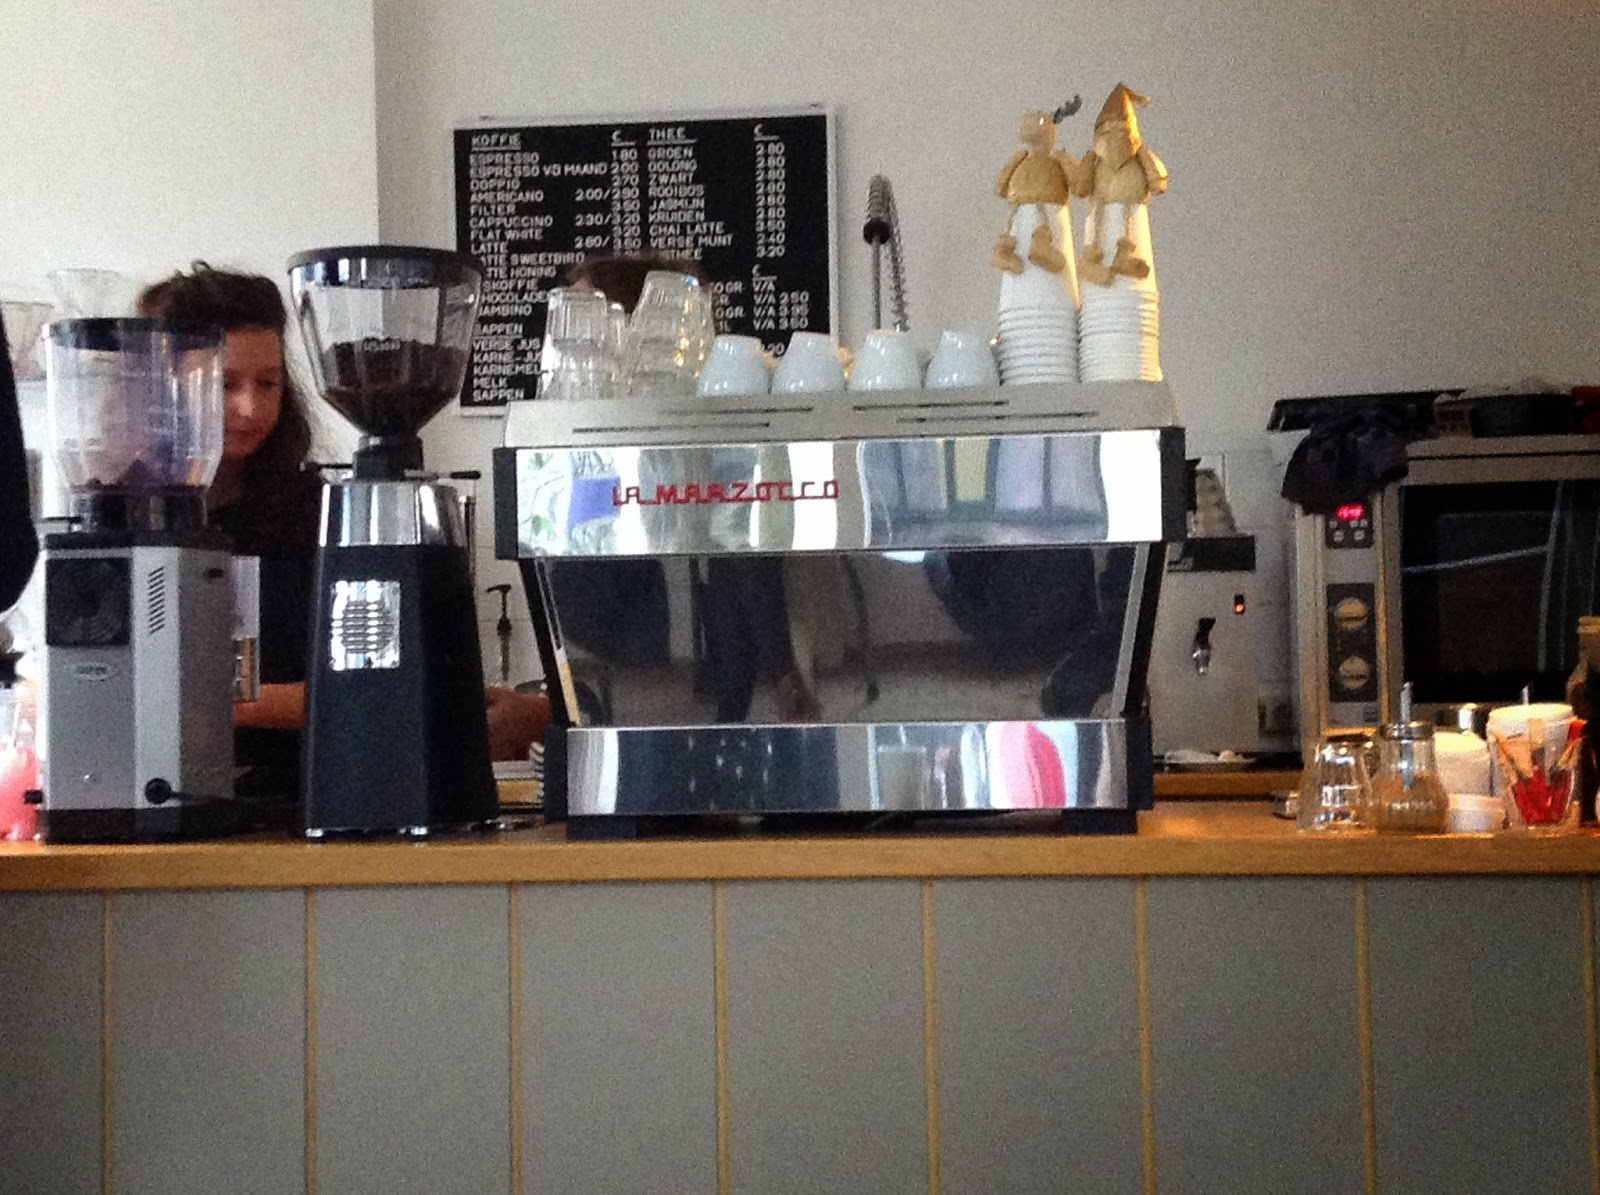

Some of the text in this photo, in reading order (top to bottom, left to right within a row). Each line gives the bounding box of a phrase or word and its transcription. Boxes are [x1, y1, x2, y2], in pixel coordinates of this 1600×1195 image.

[471, 133, 521, 146] KOFFIE
[649, 127, 686, 140] THEE
[470, 153, 539, 165] ESPRESSO
[648, 147, 693, 159] GROEN
[470, 166, 540, 178] ESPRESSO
[564, 162, 608, 176] MAAND
[648, 160, 697, 172] OOLONG
[470, 179, 520, 191] DOPPIO
[649, 172, 694, 186] ZWART
[470, 190, 544, 203] AMERICANO
[648, 185, 704, 198] ROOIBOS
[470, 203, 516, 216] FILTER
[649, 198, 705, 211] JASMIJN
[469, 215, 553, 228] CAPPUCCINO
[648, 210, 705, 223] KRUIDEN
[470, 229, 501, 242] FLAT
[504, 228, 544, 241] WHITE
[649, 223, 680, 236] CHAI
[686, 221, 724, 234] LATTE
[470, 241, 508, 254] LATTE
[649, 236, 695, 249] VERSE
[698, 234, 733, 247] MUNT
[510, 266, 557, 279] HONING
[482, 279, 540, 292] SKOFFIE
[473, 339, 513, 352] VERSE
[473, 364, 541, 376] KARNEMEL
[473, 376, 507, 389] MELK
[473, 387, 525, 402] SAPPEN
[612, 486, 640, 506] LA
